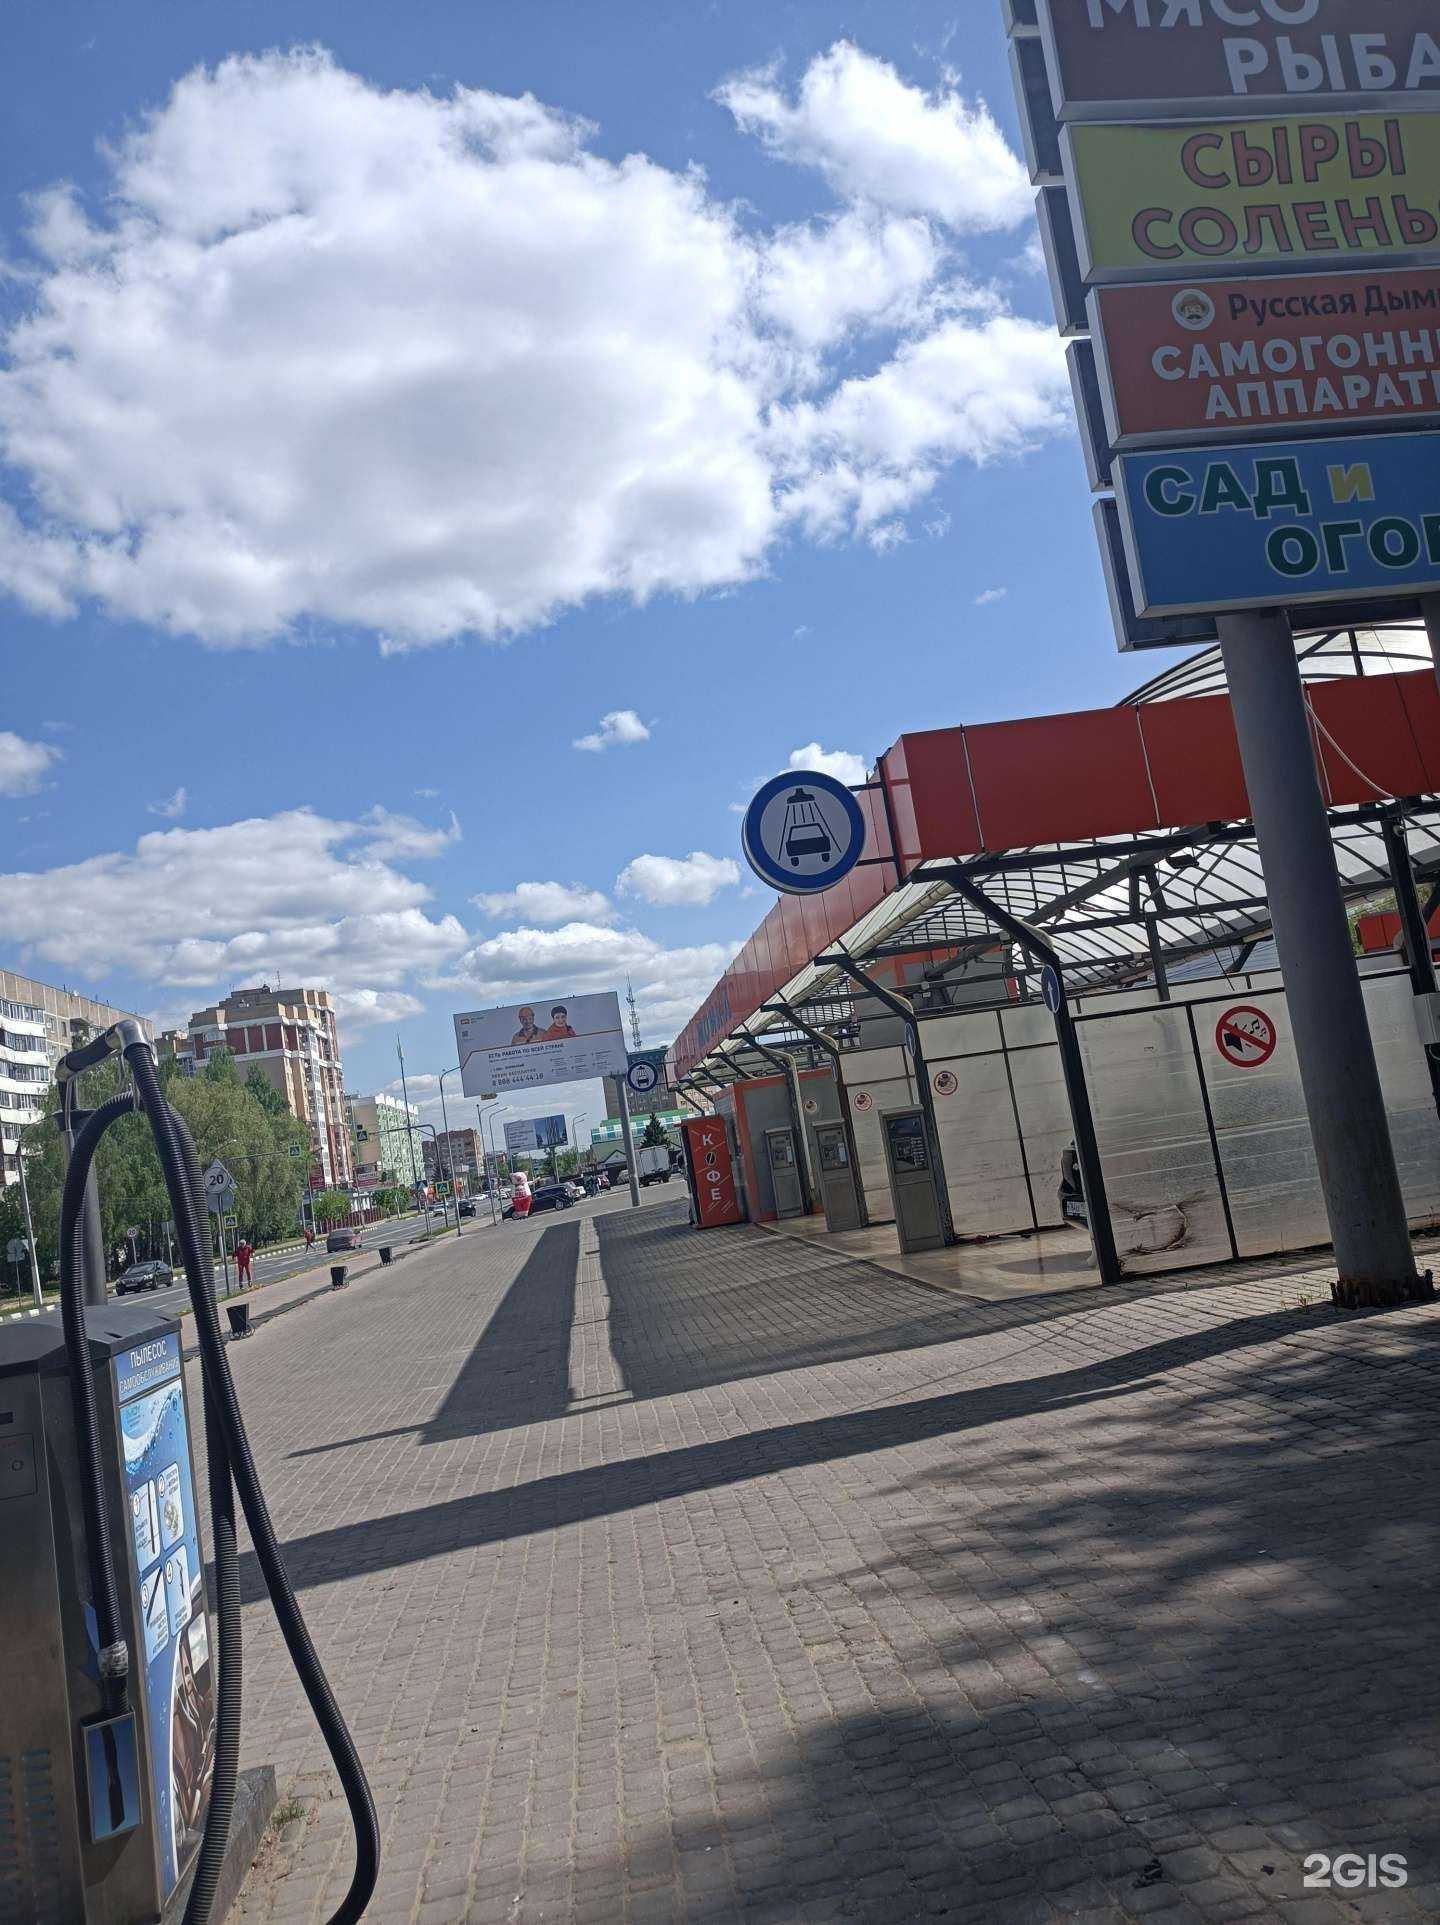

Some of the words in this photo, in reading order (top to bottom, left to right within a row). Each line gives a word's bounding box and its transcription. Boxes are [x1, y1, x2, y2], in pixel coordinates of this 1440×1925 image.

[1222, 33, 1440, 94] РЫБА
[1181, 119, 1406, 189] СЫРЫ
[1131, 195, 1440, 259] СОЛЕНЬ
[1228, 291, 1357, 326] Русская
[1364, 285, 1440, 317] Дым
[1151, 328, 1440, 381] САМОГОНН
[1205, 369, 1440, 420] АППАРАТ
[1143, 456, 1313, 519] САД
[209, 1174, 224, 1186] 20
[130, 1339, 167, 1369] ПЫЛЕСОС
